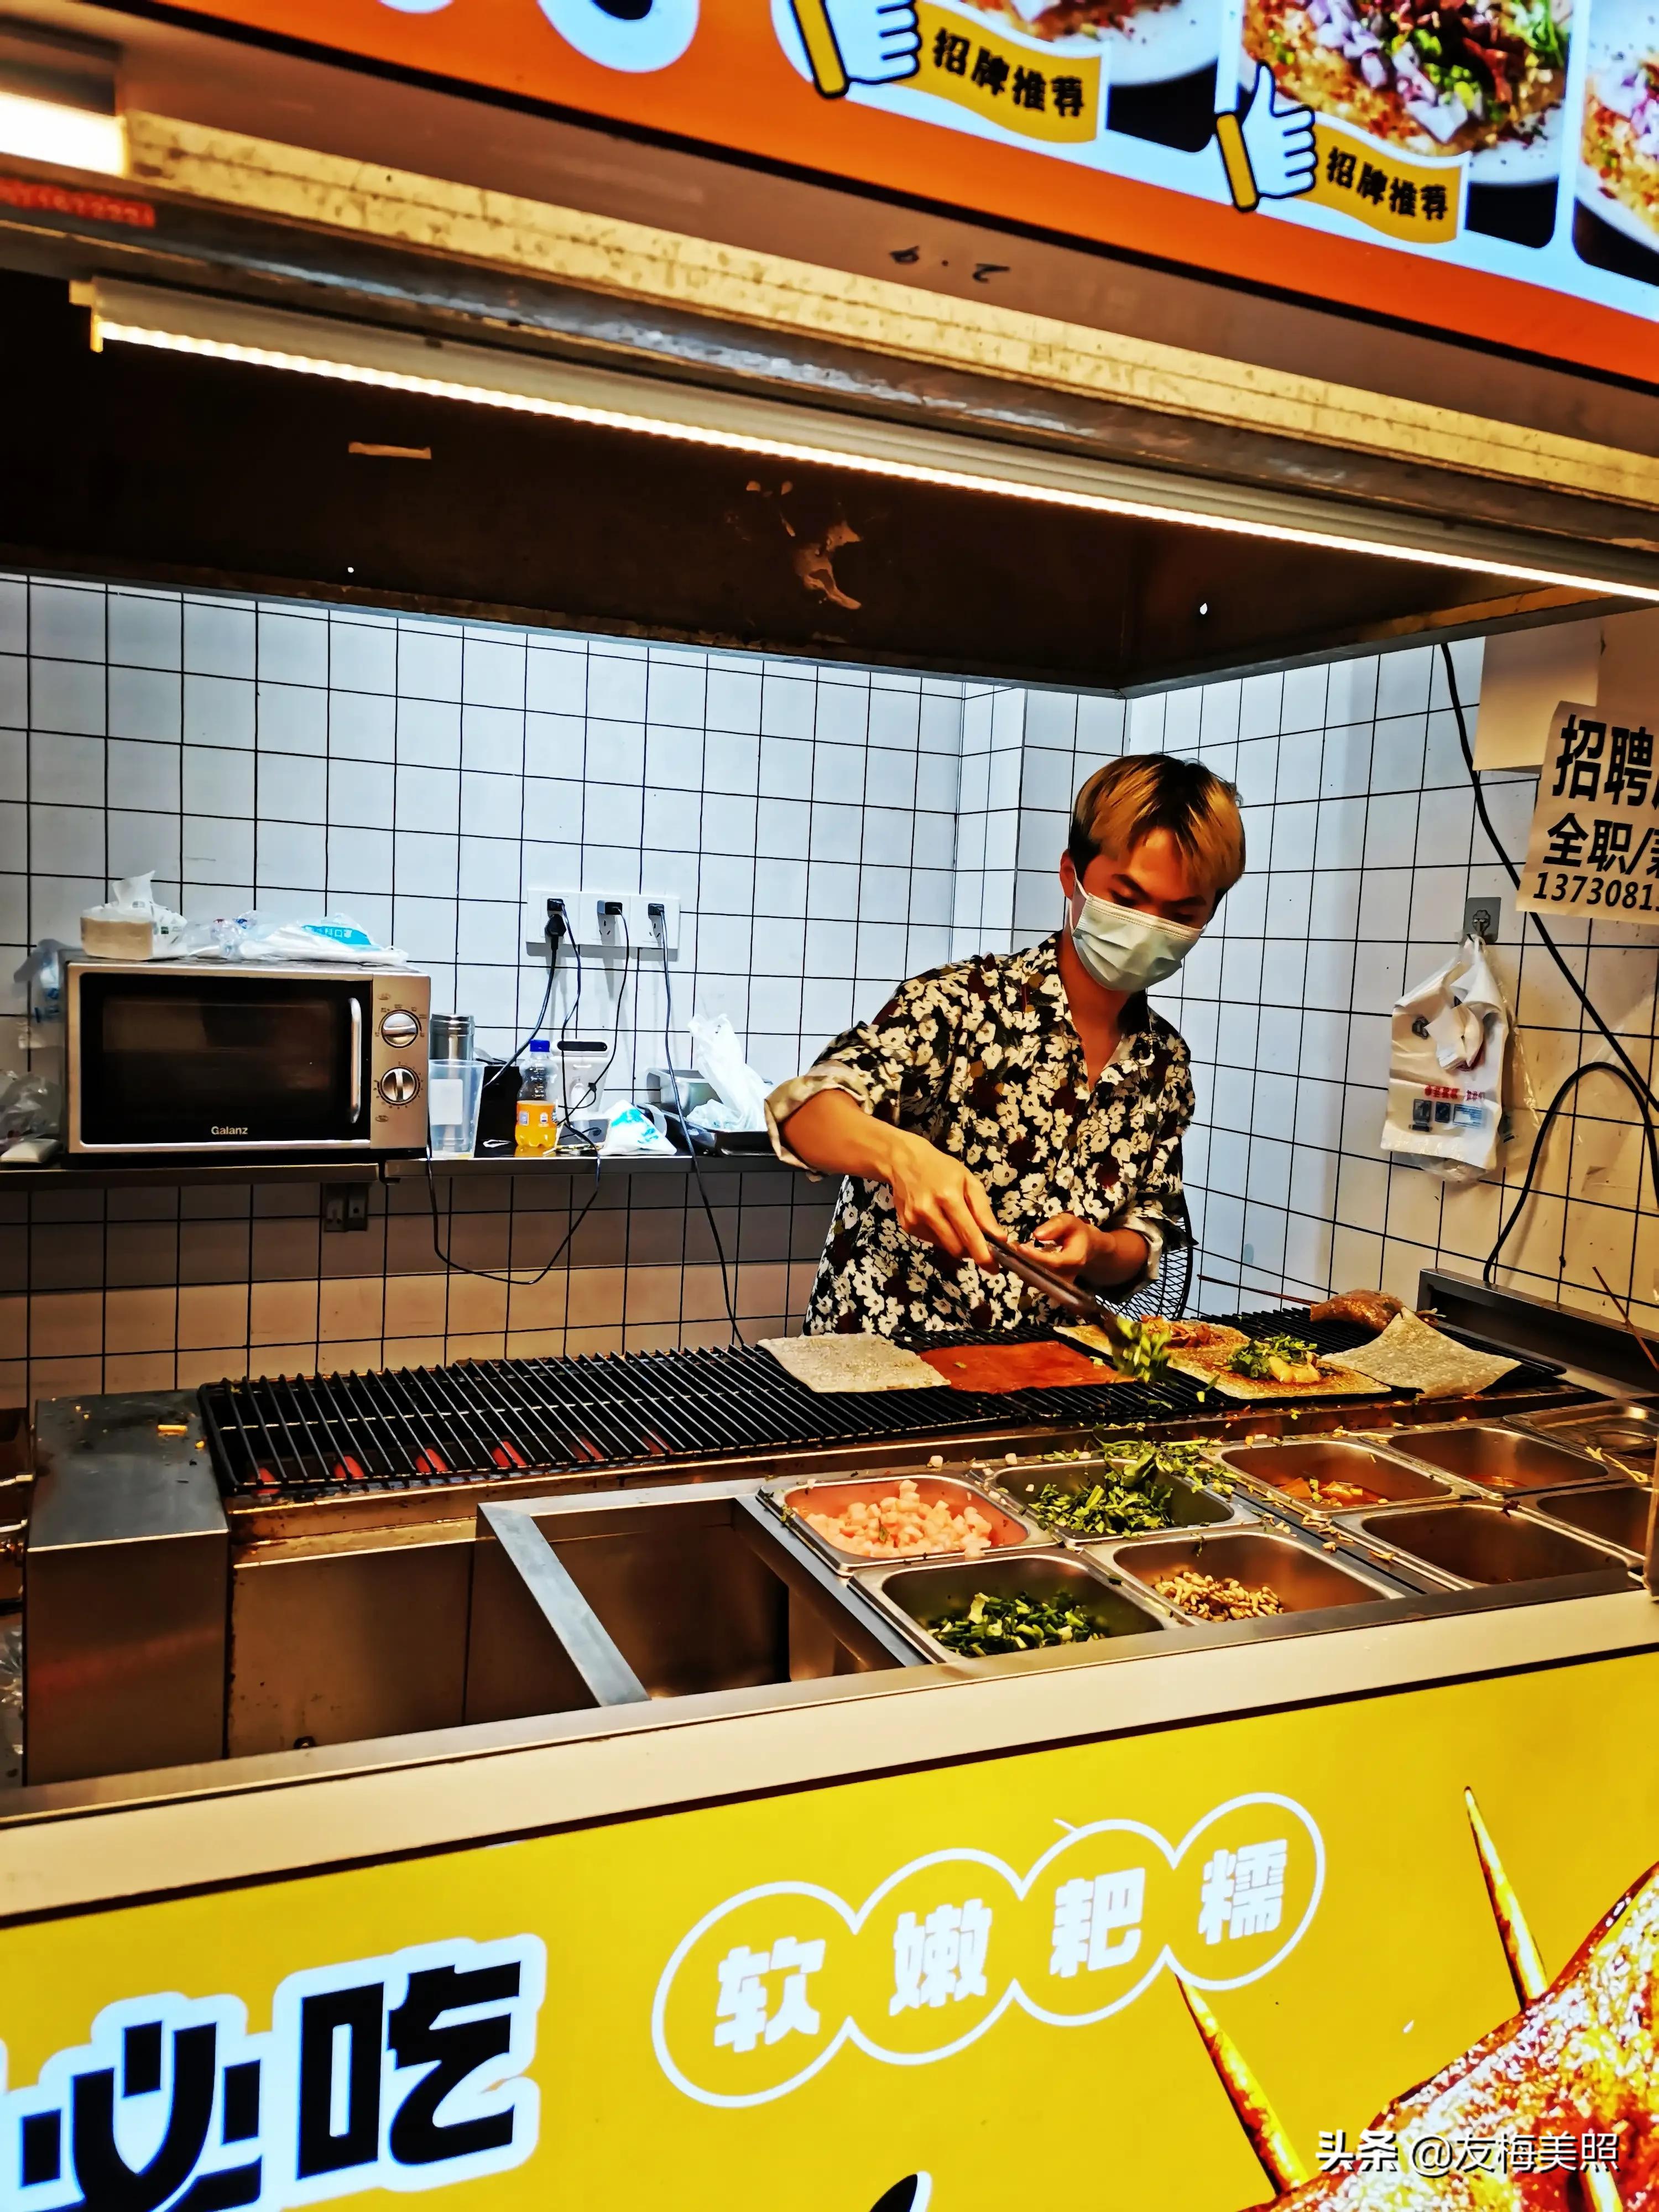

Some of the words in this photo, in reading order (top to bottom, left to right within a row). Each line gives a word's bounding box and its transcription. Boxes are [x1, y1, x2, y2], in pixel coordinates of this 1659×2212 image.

[932, 27, 1084, 117] 招牌推荐
[1327, 147, 1448, 221] 招牌推荐
[1552, 714, 1659, 811] 招聘
[1533, 872, 1659, 912] 1373081
[211, 1126, 248, 1135] Galanz
